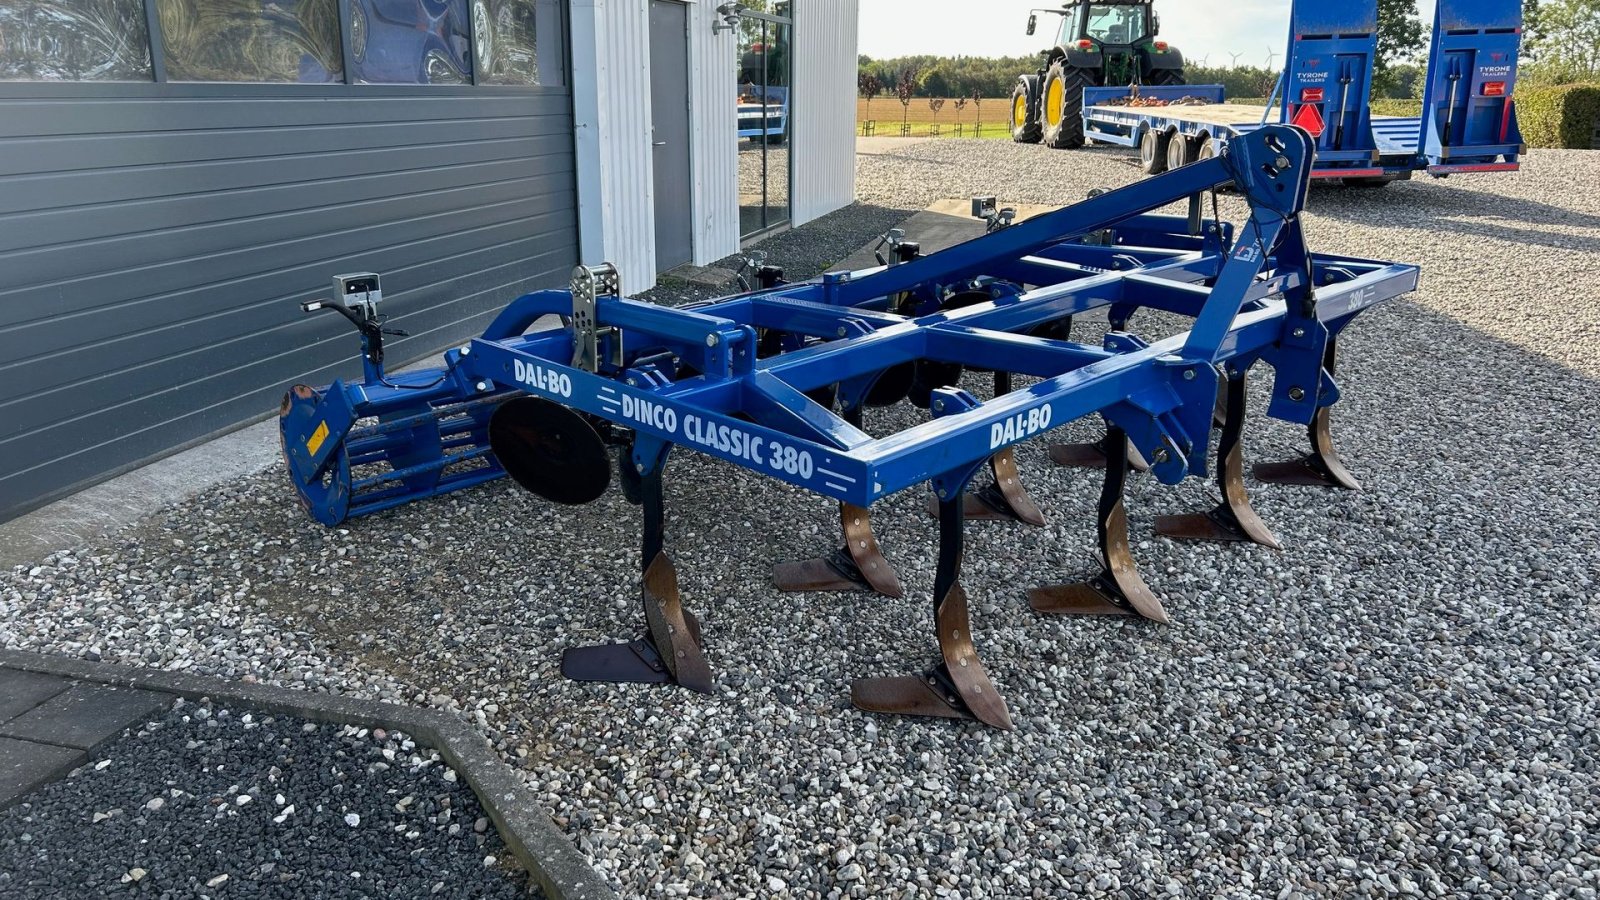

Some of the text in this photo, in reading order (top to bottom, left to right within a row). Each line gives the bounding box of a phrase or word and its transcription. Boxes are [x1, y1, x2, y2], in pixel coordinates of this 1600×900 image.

[1348, 289, 1364, 310] 380
[622, 393, 813, 479] DINCO CLASSIC 380
